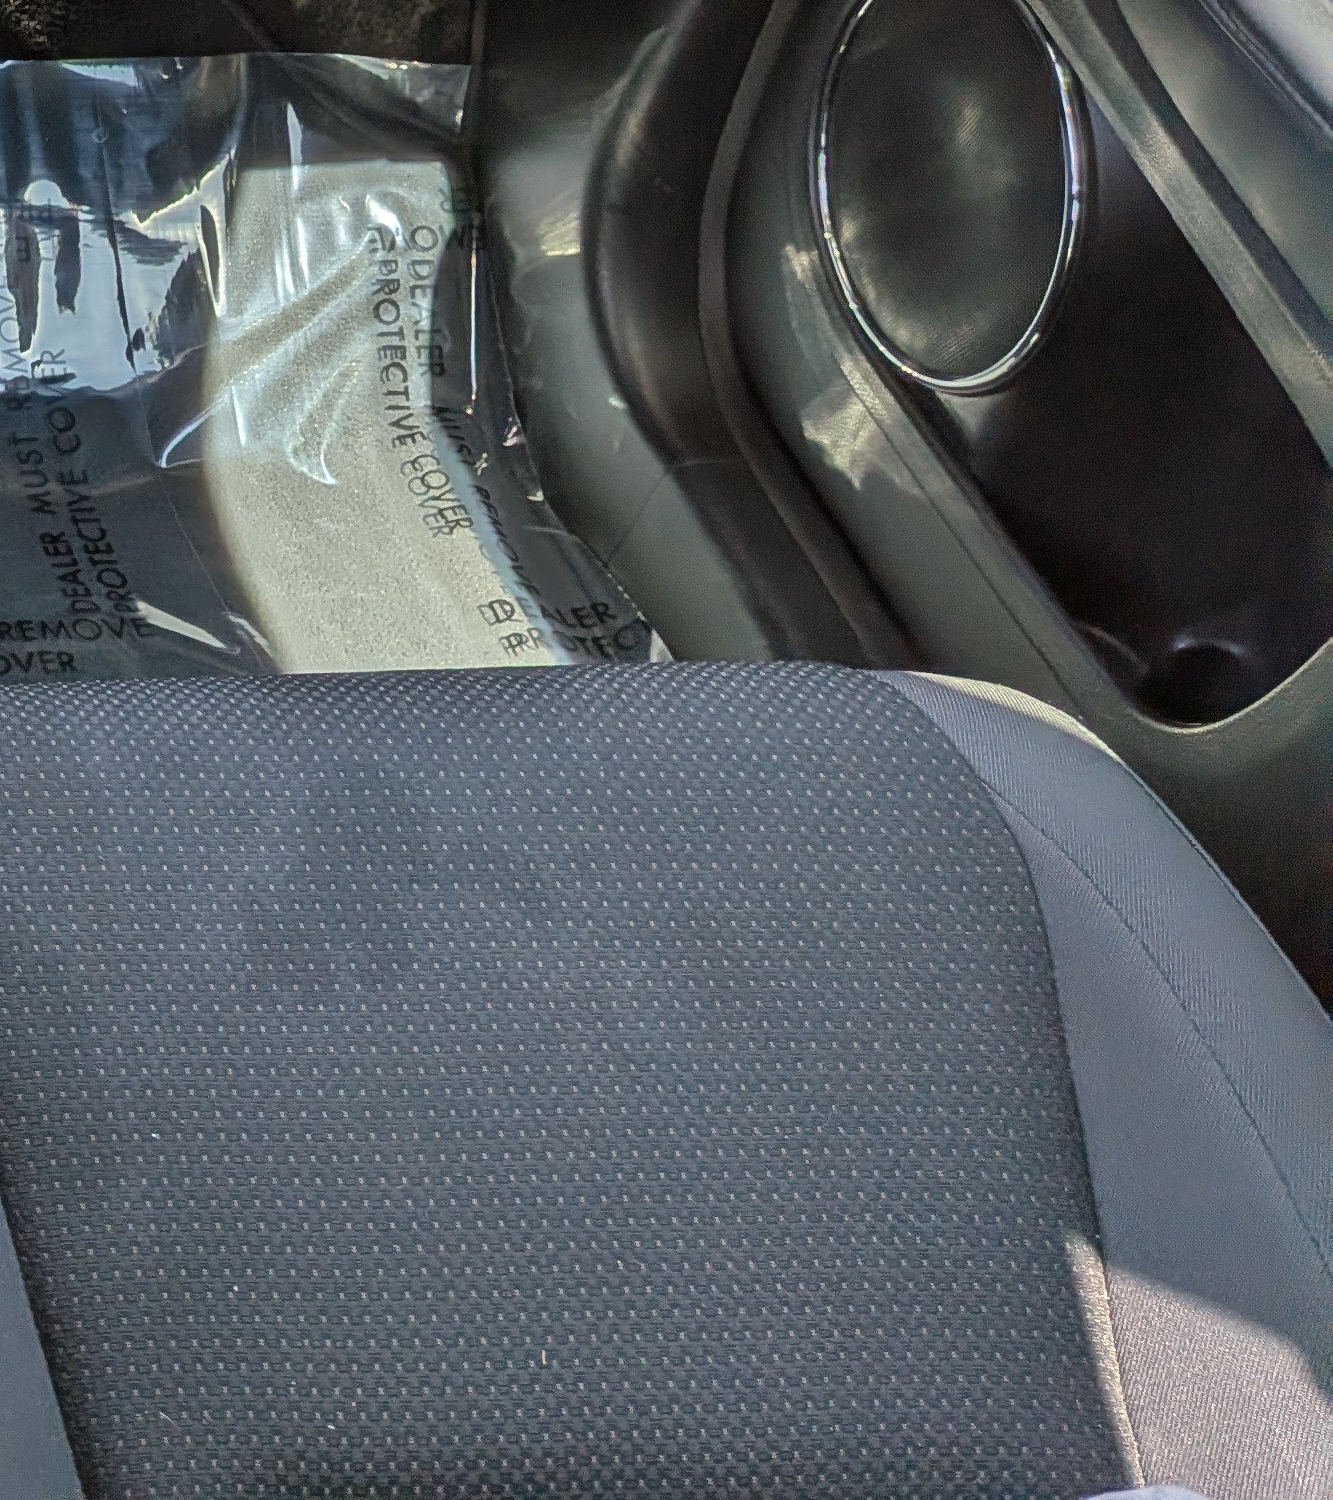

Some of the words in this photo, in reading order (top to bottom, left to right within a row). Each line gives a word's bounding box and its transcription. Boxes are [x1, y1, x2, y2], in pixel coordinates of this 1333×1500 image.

[407, 258, 446, 378] DEALER
[372, 258, 428, 449] PROTECTIVE
[412, 453, 474, 530] COVER
[7, 435, 58, 517] MUST
[39, 529, 101, 616] DEALER
[55, 468, 139, 614] PROTECTIVE
